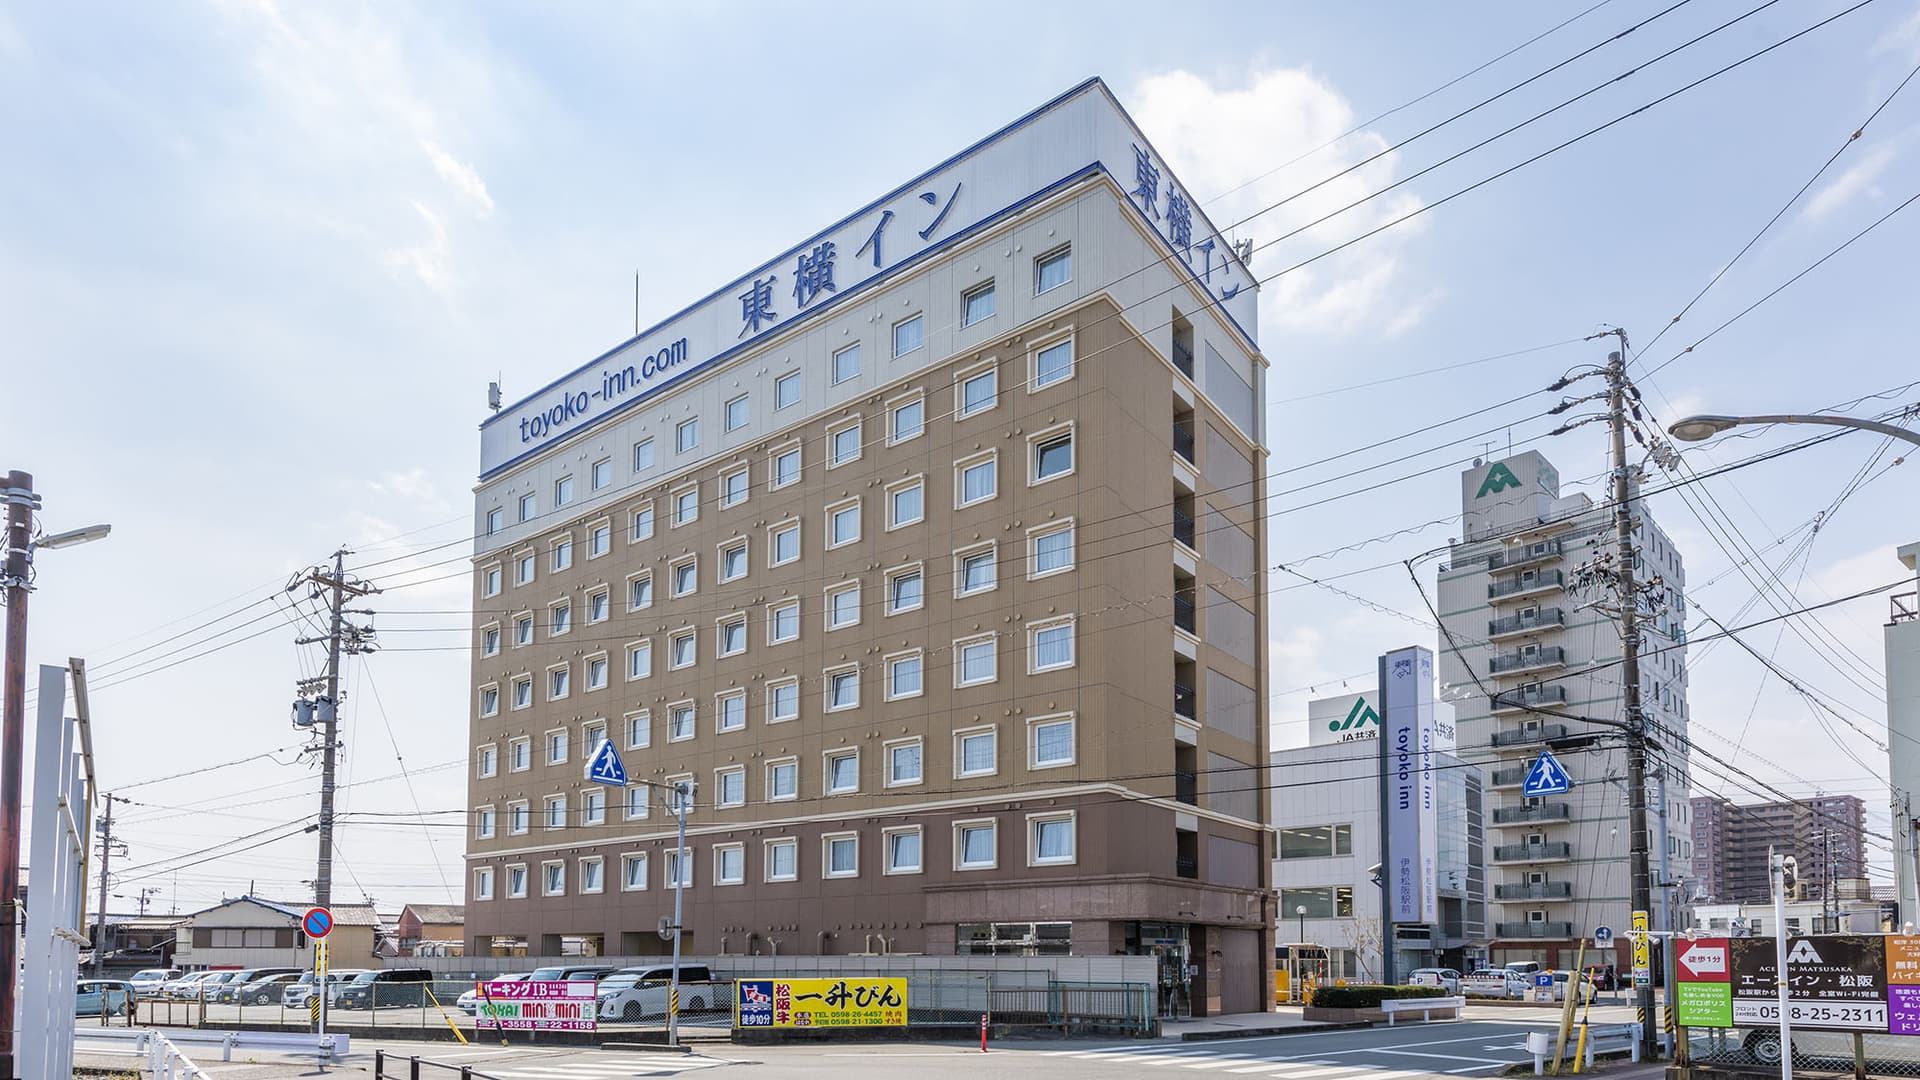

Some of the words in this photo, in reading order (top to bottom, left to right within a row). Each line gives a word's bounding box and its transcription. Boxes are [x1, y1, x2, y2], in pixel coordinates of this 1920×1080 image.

[1130, 142, 1240, 301] 東横イン
[737, 181, 962, 340] 東横イン
[519, 337, 688, 443] toyoko-inn.com
[1396, 726, 1411, 780] toyoko
[1422, 728, 1431, 780] toyoko
[1399, 785, 1412, 810] inn
[1424, 785, 1432, 809] inn
[1687, 955, 1721, 963] 徒歩1分
[1416, 977, 1423, 985] P
[1539, 976, 1549, 986] P
[775, 983, 791, 1024] 松阪牛
[794, 981, 902, 1010] 一升びん
[480, 1003, 519, 1017] TOKAI
[741, 1014, 772, 1026] 徒歩10分
[1759, 1006, 1884, 1022] 058-25-2311
